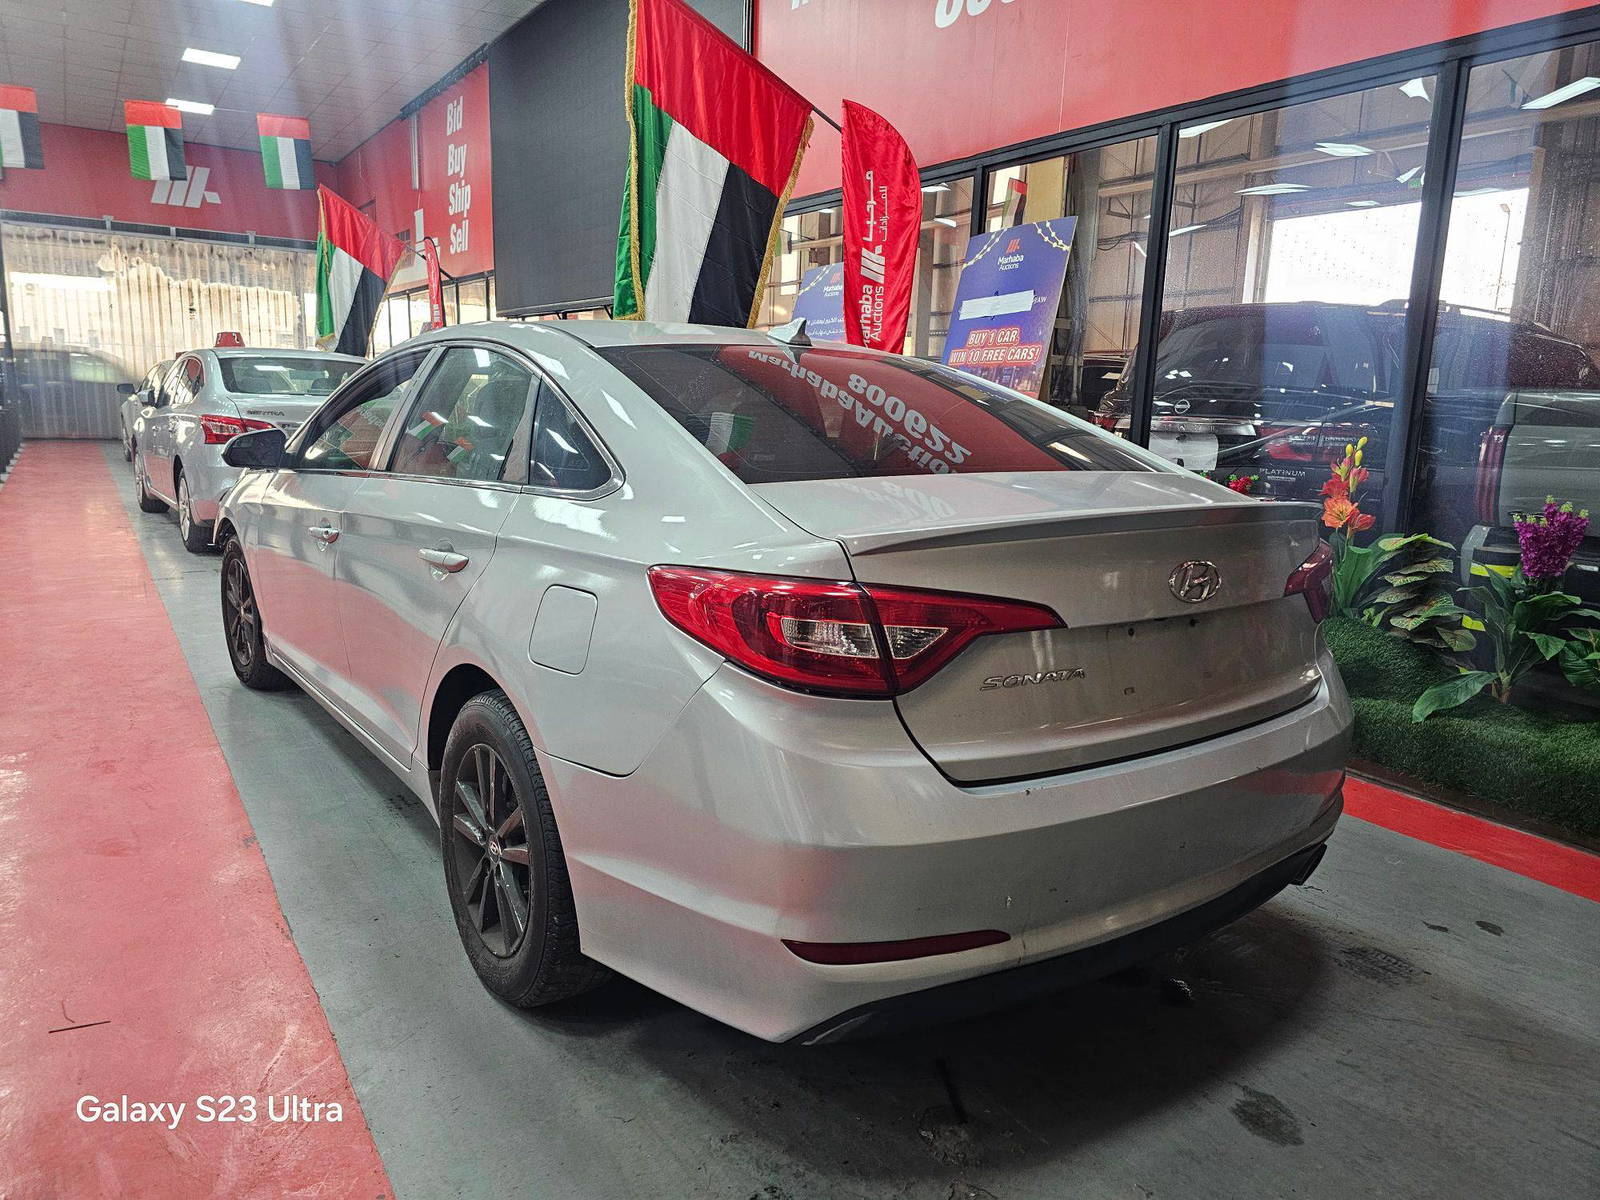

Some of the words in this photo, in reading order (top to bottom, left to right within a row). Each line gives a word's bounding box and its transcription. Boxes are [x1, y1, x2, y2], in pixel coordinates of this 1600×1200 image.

[447, 96, 464, 136] Bid
[447, 143, 467, 178] Buy
[449, 179, 471, 218] Ship
[450, 219, 470, 255] Sell
[997, 254, 1024, 266] Marhaba
[998, 262, 1019, 271] Auctions
[871, 286, 884, 342] Auctions
[968, 330, 986, 345] BUY
[988, 331, 995, 344] 1
[950, 351, 966, 363] WIN
[968, 349, 980, 362] 10
[981, 348, 1005, 361] FREE
[1007, 346, 1040, 361] CARS!
[1259, 467, 1306, 477] PLATINUM
[980, 667, 1086, 691] SONATA
